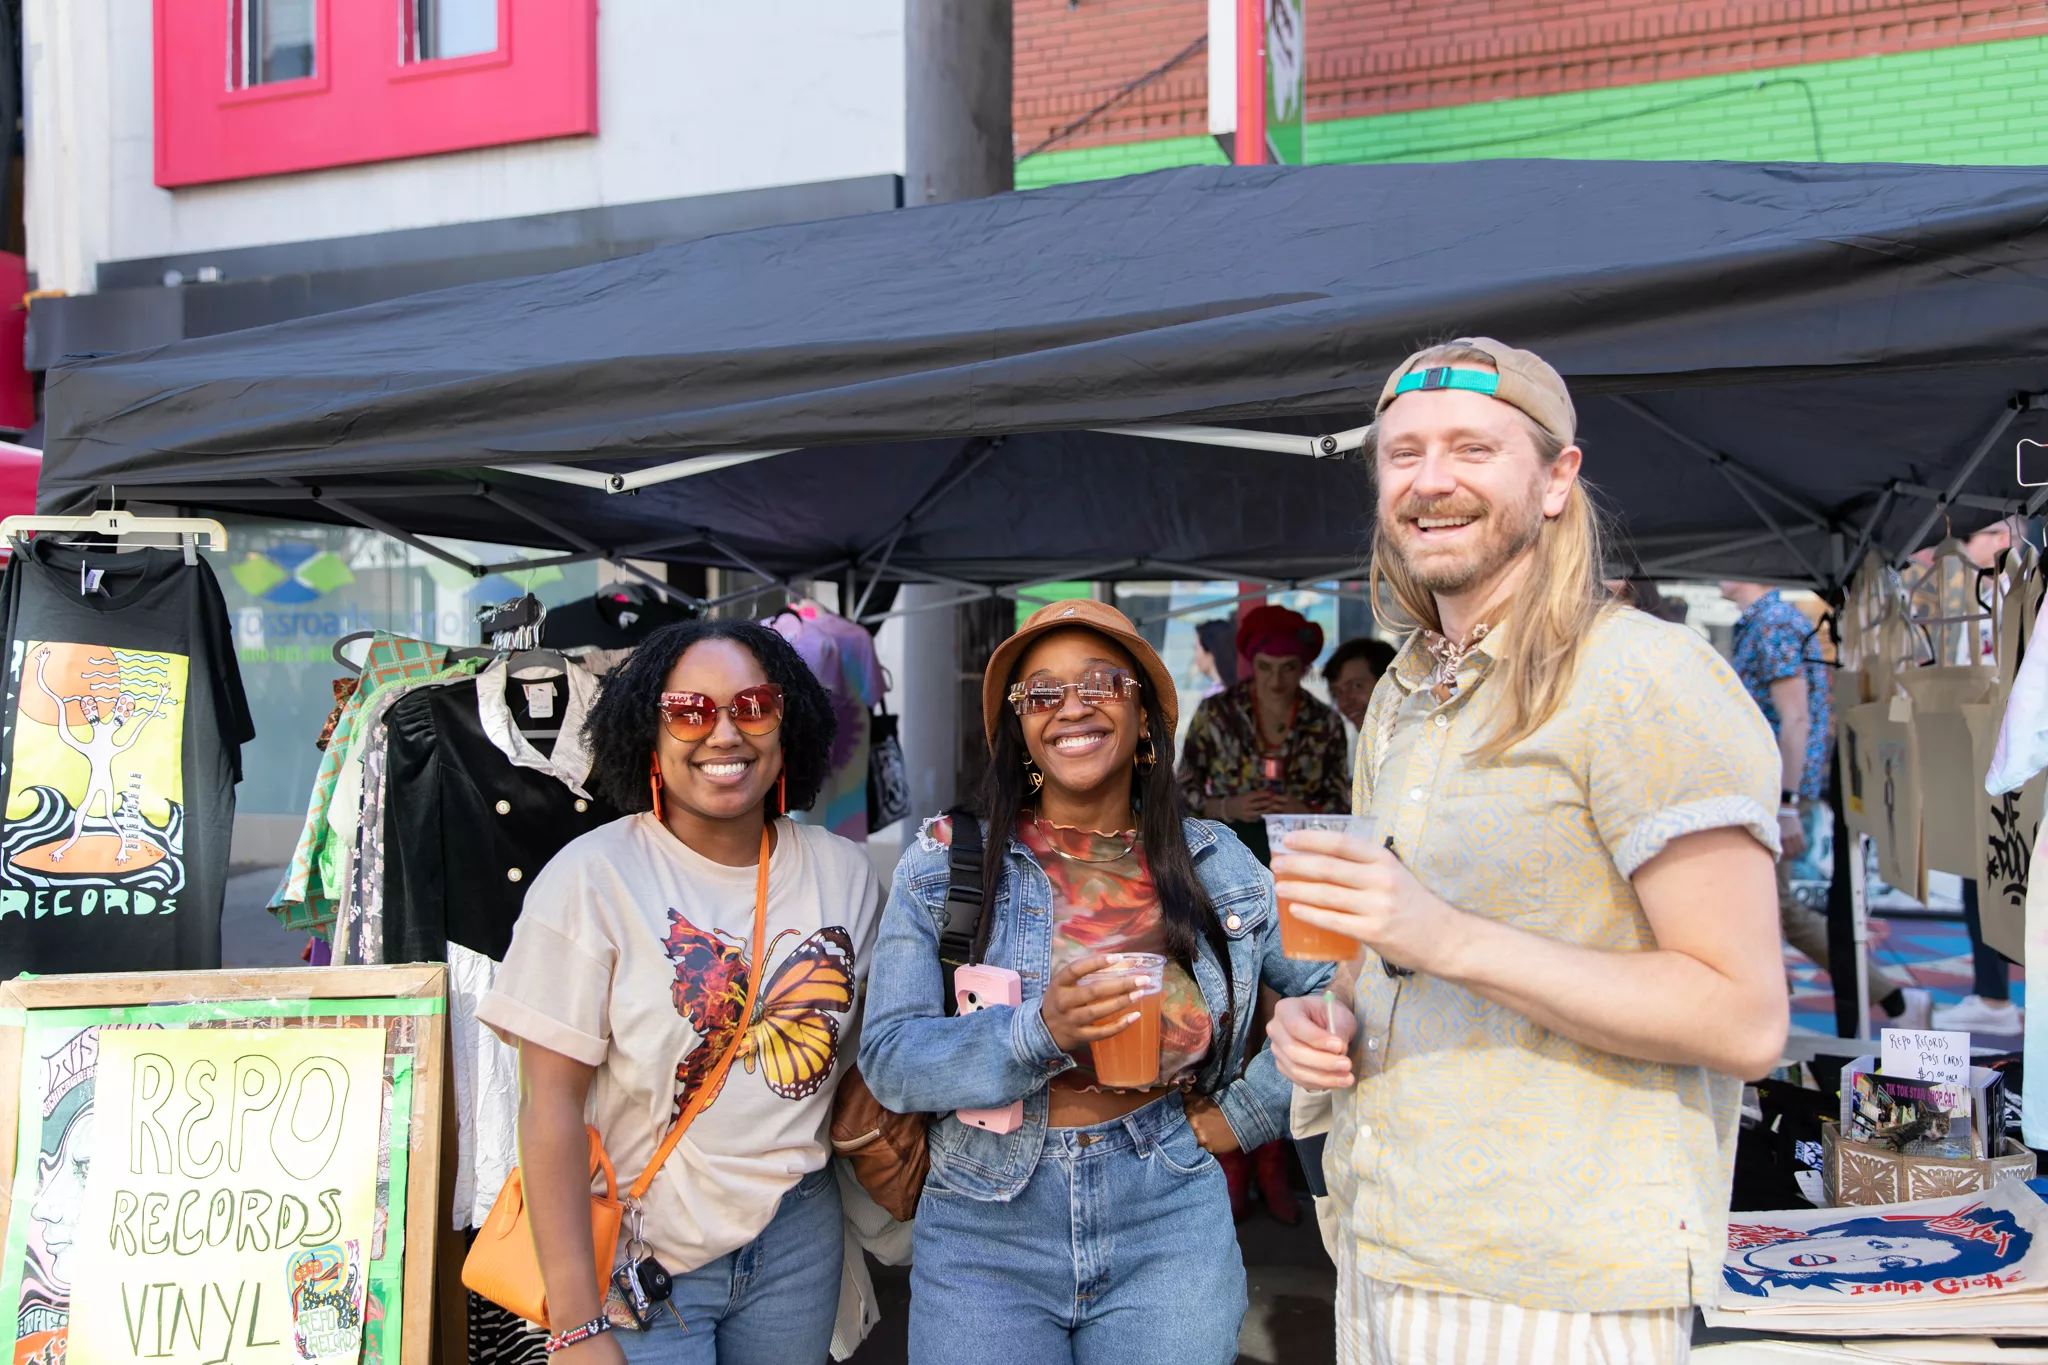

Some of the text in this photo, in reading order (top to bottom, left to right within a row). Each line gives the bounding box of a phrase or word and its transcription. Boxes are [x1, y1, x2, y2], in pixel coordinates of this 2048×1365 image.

[0, 888, 177, 920] RECORDS
[1889, 1033, 1911, 1050] REPO
[1943, 1053, 1964, 1068] CARDS
[1886, 1082, 1895, 1095] TIK
[1897, 1084, 1908, 1097] TOK
[1944, 1091, 1956, 1104] CAT
[130, 1052, 350, 1180] REPO
[110, 1188, 342, 1256] RECORDS
[121, 1279, 281, 1365] VINYL
[298, 1307, 336, 1336] REPO
